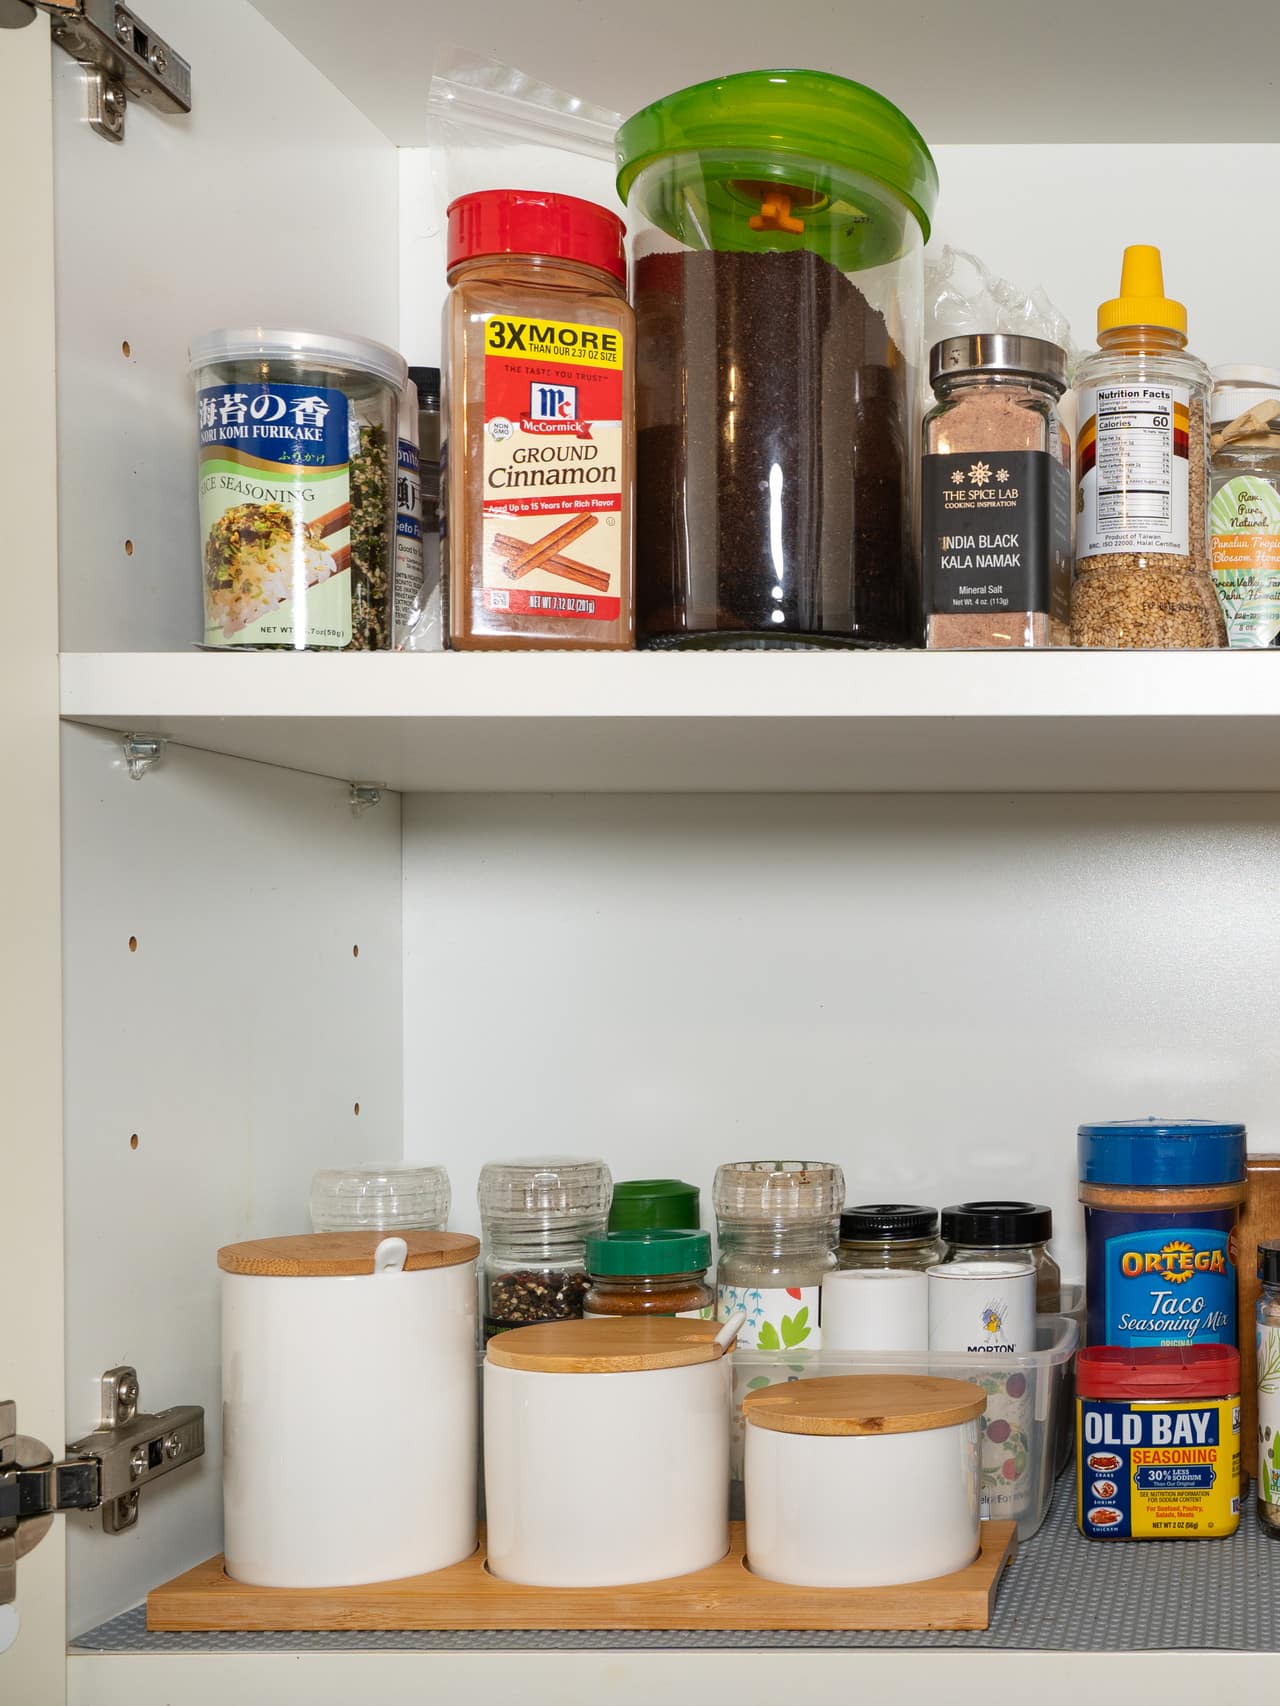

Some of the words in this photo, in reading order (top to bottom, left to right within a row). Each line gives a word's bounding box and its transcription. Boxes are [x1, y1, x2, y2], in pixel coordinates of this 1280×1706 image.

[529, 325, 617, 352] MORE
[529, 343, 551, 355] THAN
[554, 345, 570, 357] OUR
[572, 348, 586, 359] 2.37
[588, 350, 599, 360] OZ
[601, 352, 617, 363] SIZE
[504, 365, 521, 374] THE
[525, 367, 551, 377] TASTE
[555, 370, 573, 379] YOU
[1098, 390, 1140, 400] Nutrition
[1143, 390, 1170, 399] Facts
[200, 393, 330, 429] 海苔の香
[493, 422, 509, 430] NON
[522, 419, 584, 434] McCormick
[1099, 421, 1132, 429] Calories
[1152, 416, 1169, 428] 60
[219, 425, 249, 440] KOMI
[252, 425, 323, 442] FURIKAKE
[513, 445, 598, 464] GROUND
[488, 465, 617, 489] Cinnamon
[219, 475, 315, 503] SEASONING
[943, 490, 966, 501] THE
[968, 489, 996, 501] SPICE
[998, 488, 1019, 499] LAB
[509, 503, 520, 513] Up
[521, 503, 530, 511] to
[531, 502, 539, 510] 15
[540, 501, 561, 510] Years
[561, 500, 573, 509] for
[574, 499, 590, 508] Rich
[592, 498, 615, 507] Flavor
[944, 501, 976, 509] COOKING
[977, 500, 1017, 509] INSPIRATION
[942, 535, 976, 550] INDIA
[978, 534, 1019, 549] BLACK
[941, 555, 973, 569] KALA
[976, 554, 1021, 569] NAMAK
[959, 585, 987, 595] Mineral
[988, 585, 1003, 594] Salt
[529, 595, 541, 609] NET
[541, 596, 551, 610] WT
[552, 596, 566, 610] 7.12
[1122, 1249, 1227, 1277] ORTEGA
[1150, 1290, 1207, 1315] Taco
[1118, 1313, 1201, 1338] Seasoning
[1202, 1311, 1229, 1332] Mix
[1085, 1411, 1143, 1445] OLD
[1151, 1412, 1211, 1446] BAY
[1132, 1449, 1217, 1465] SEASONING
[1148, 1470, 1172, 1481] 30%
